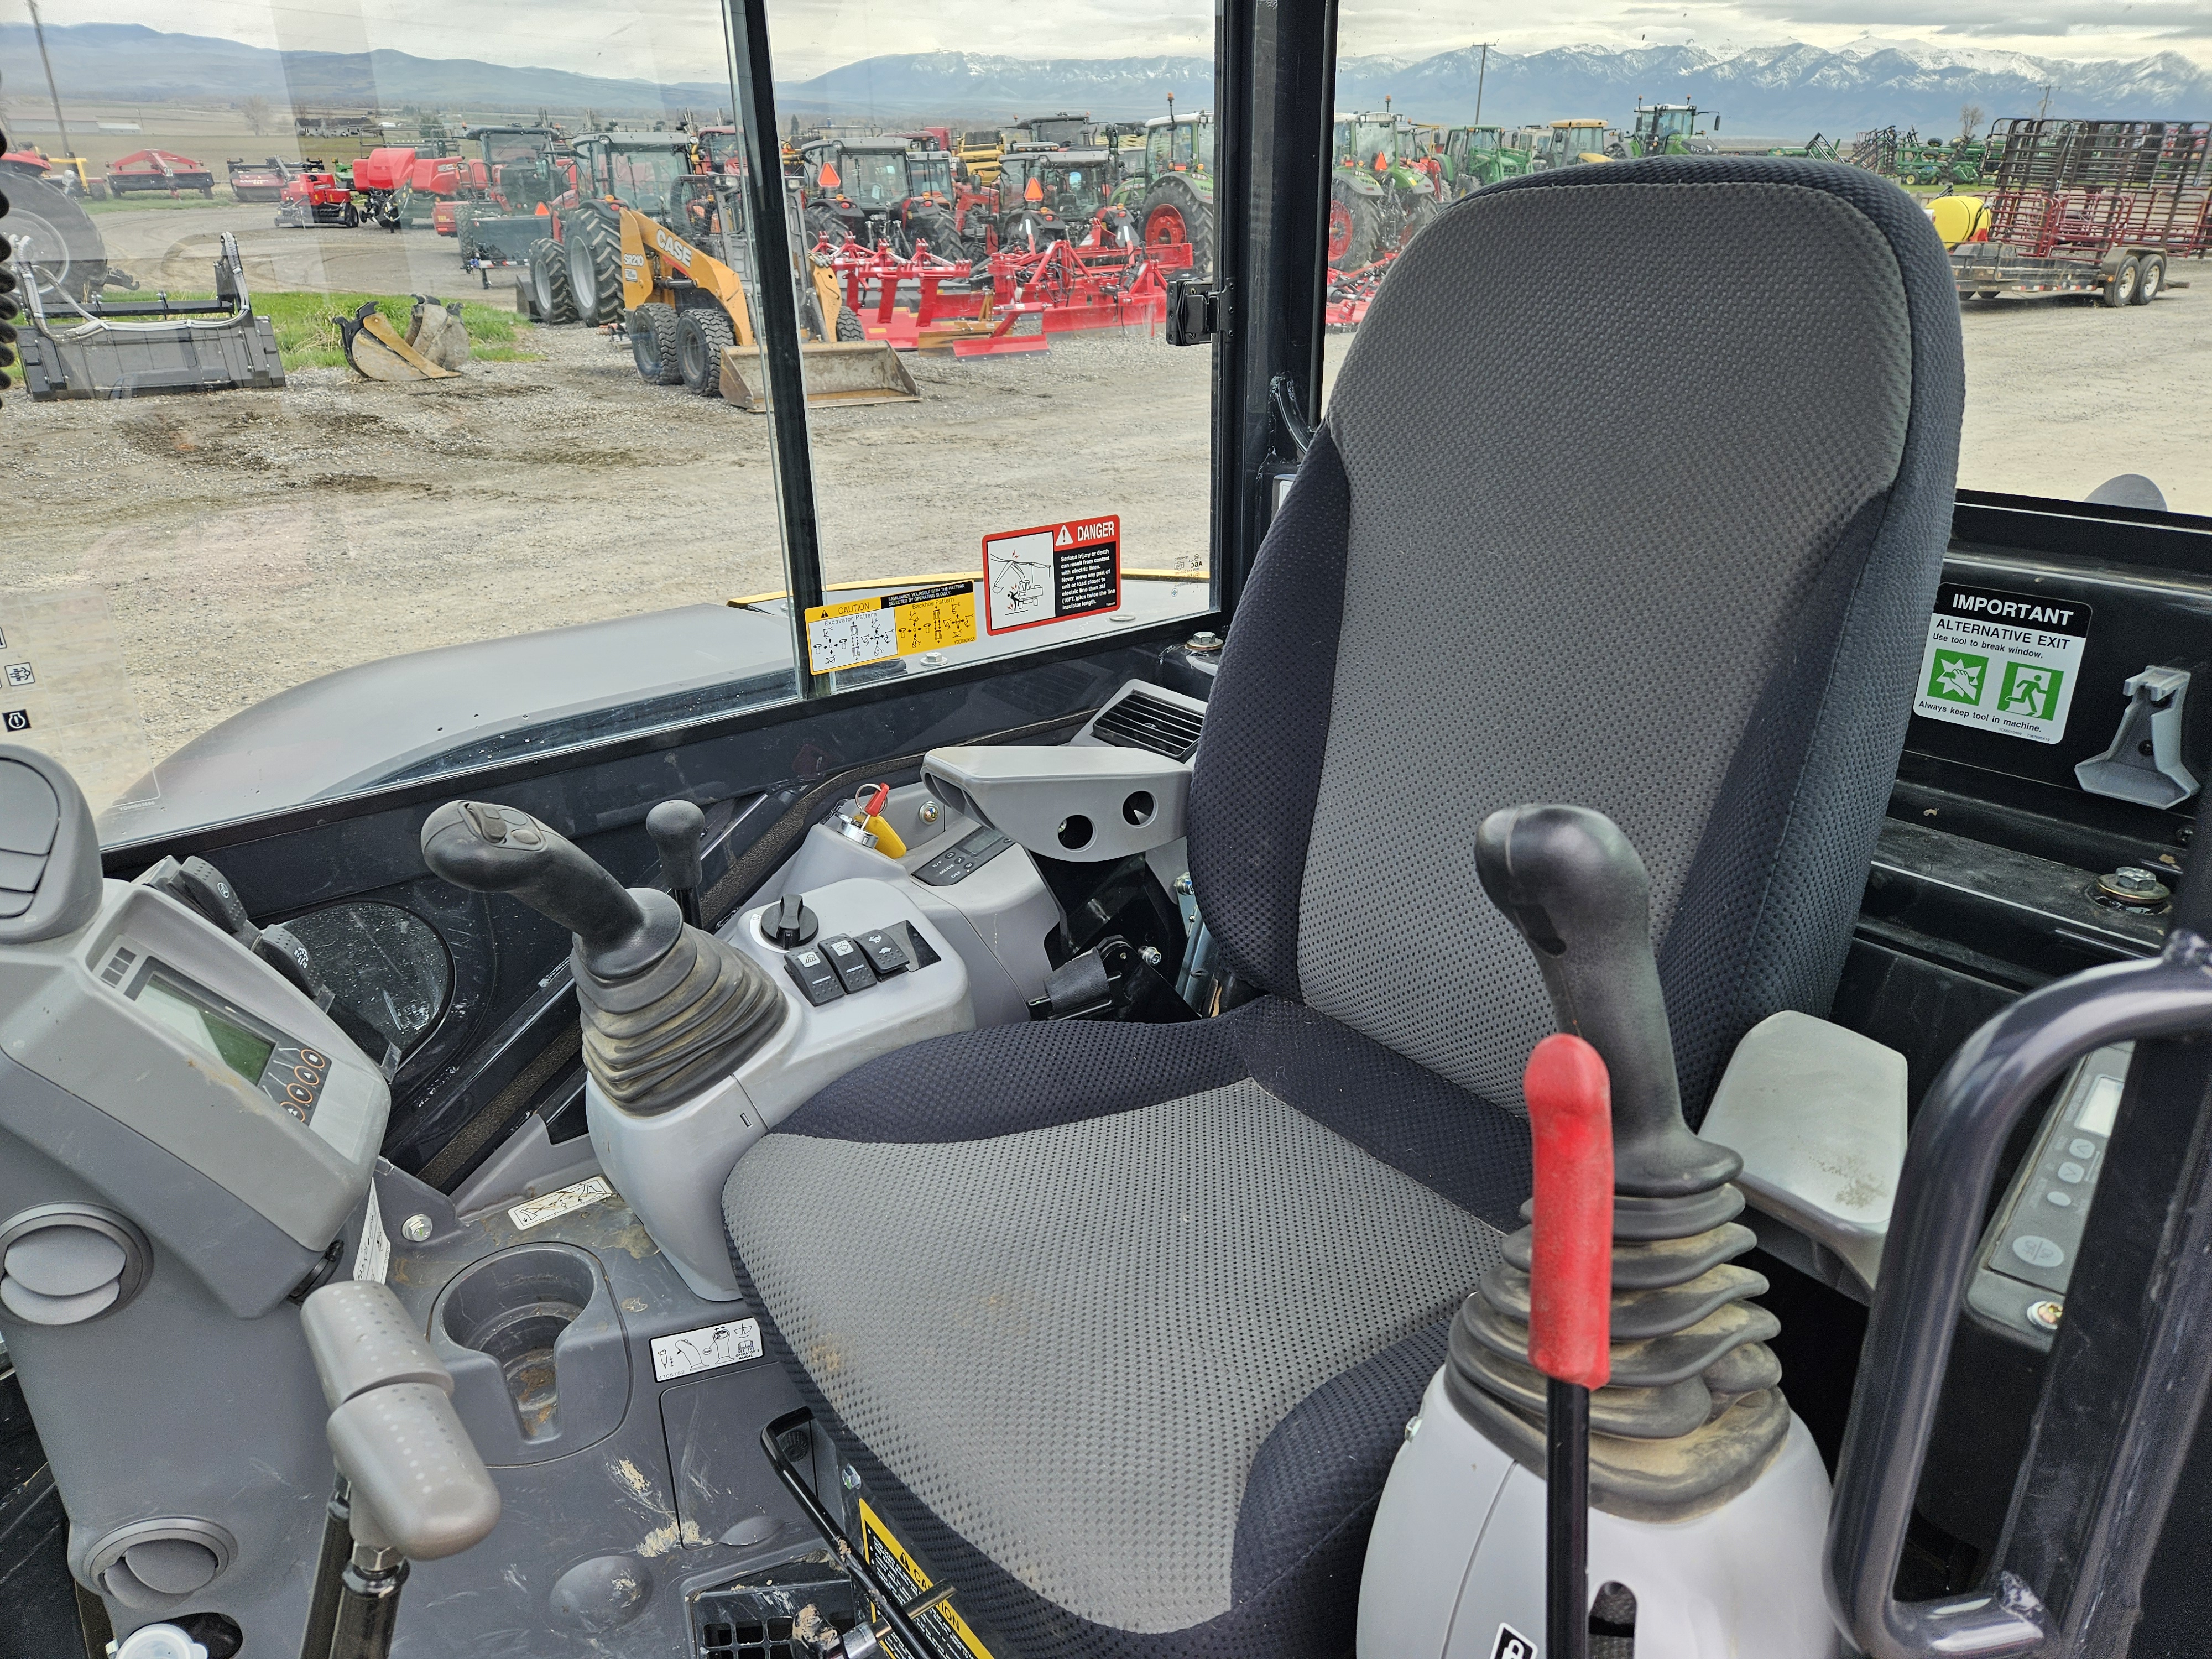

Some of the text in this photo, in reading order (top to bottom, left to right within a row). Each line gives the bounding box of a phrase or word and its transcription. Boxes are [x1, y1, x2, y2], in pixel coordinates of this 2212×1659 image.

[656, 228, 692, 268] CASE
[1077, 521, 1114, 541] DANGER
[838, 602, 870, 614] CAUTION
[1952, 593, 2074, 626] IMPORTANT
[825, 617, 853, 626] Excavator
[1936, 618, 2070, 650] ALTERNATIVE EXIT
[1933, 633, 1948, 642] Use
[1951, 636, 1967, 645] tool
[1981, 643, 2005, 652] break
[2008, 646, 2043, 659] window.
[1918, 701, 1947, 713] Always
[1950, 707, 1970, 718] keep
[1973, 712, 1989, 721] tool
[2003, 718, 2042, 732] machine.
[939, 864, 954, 875] MODE
